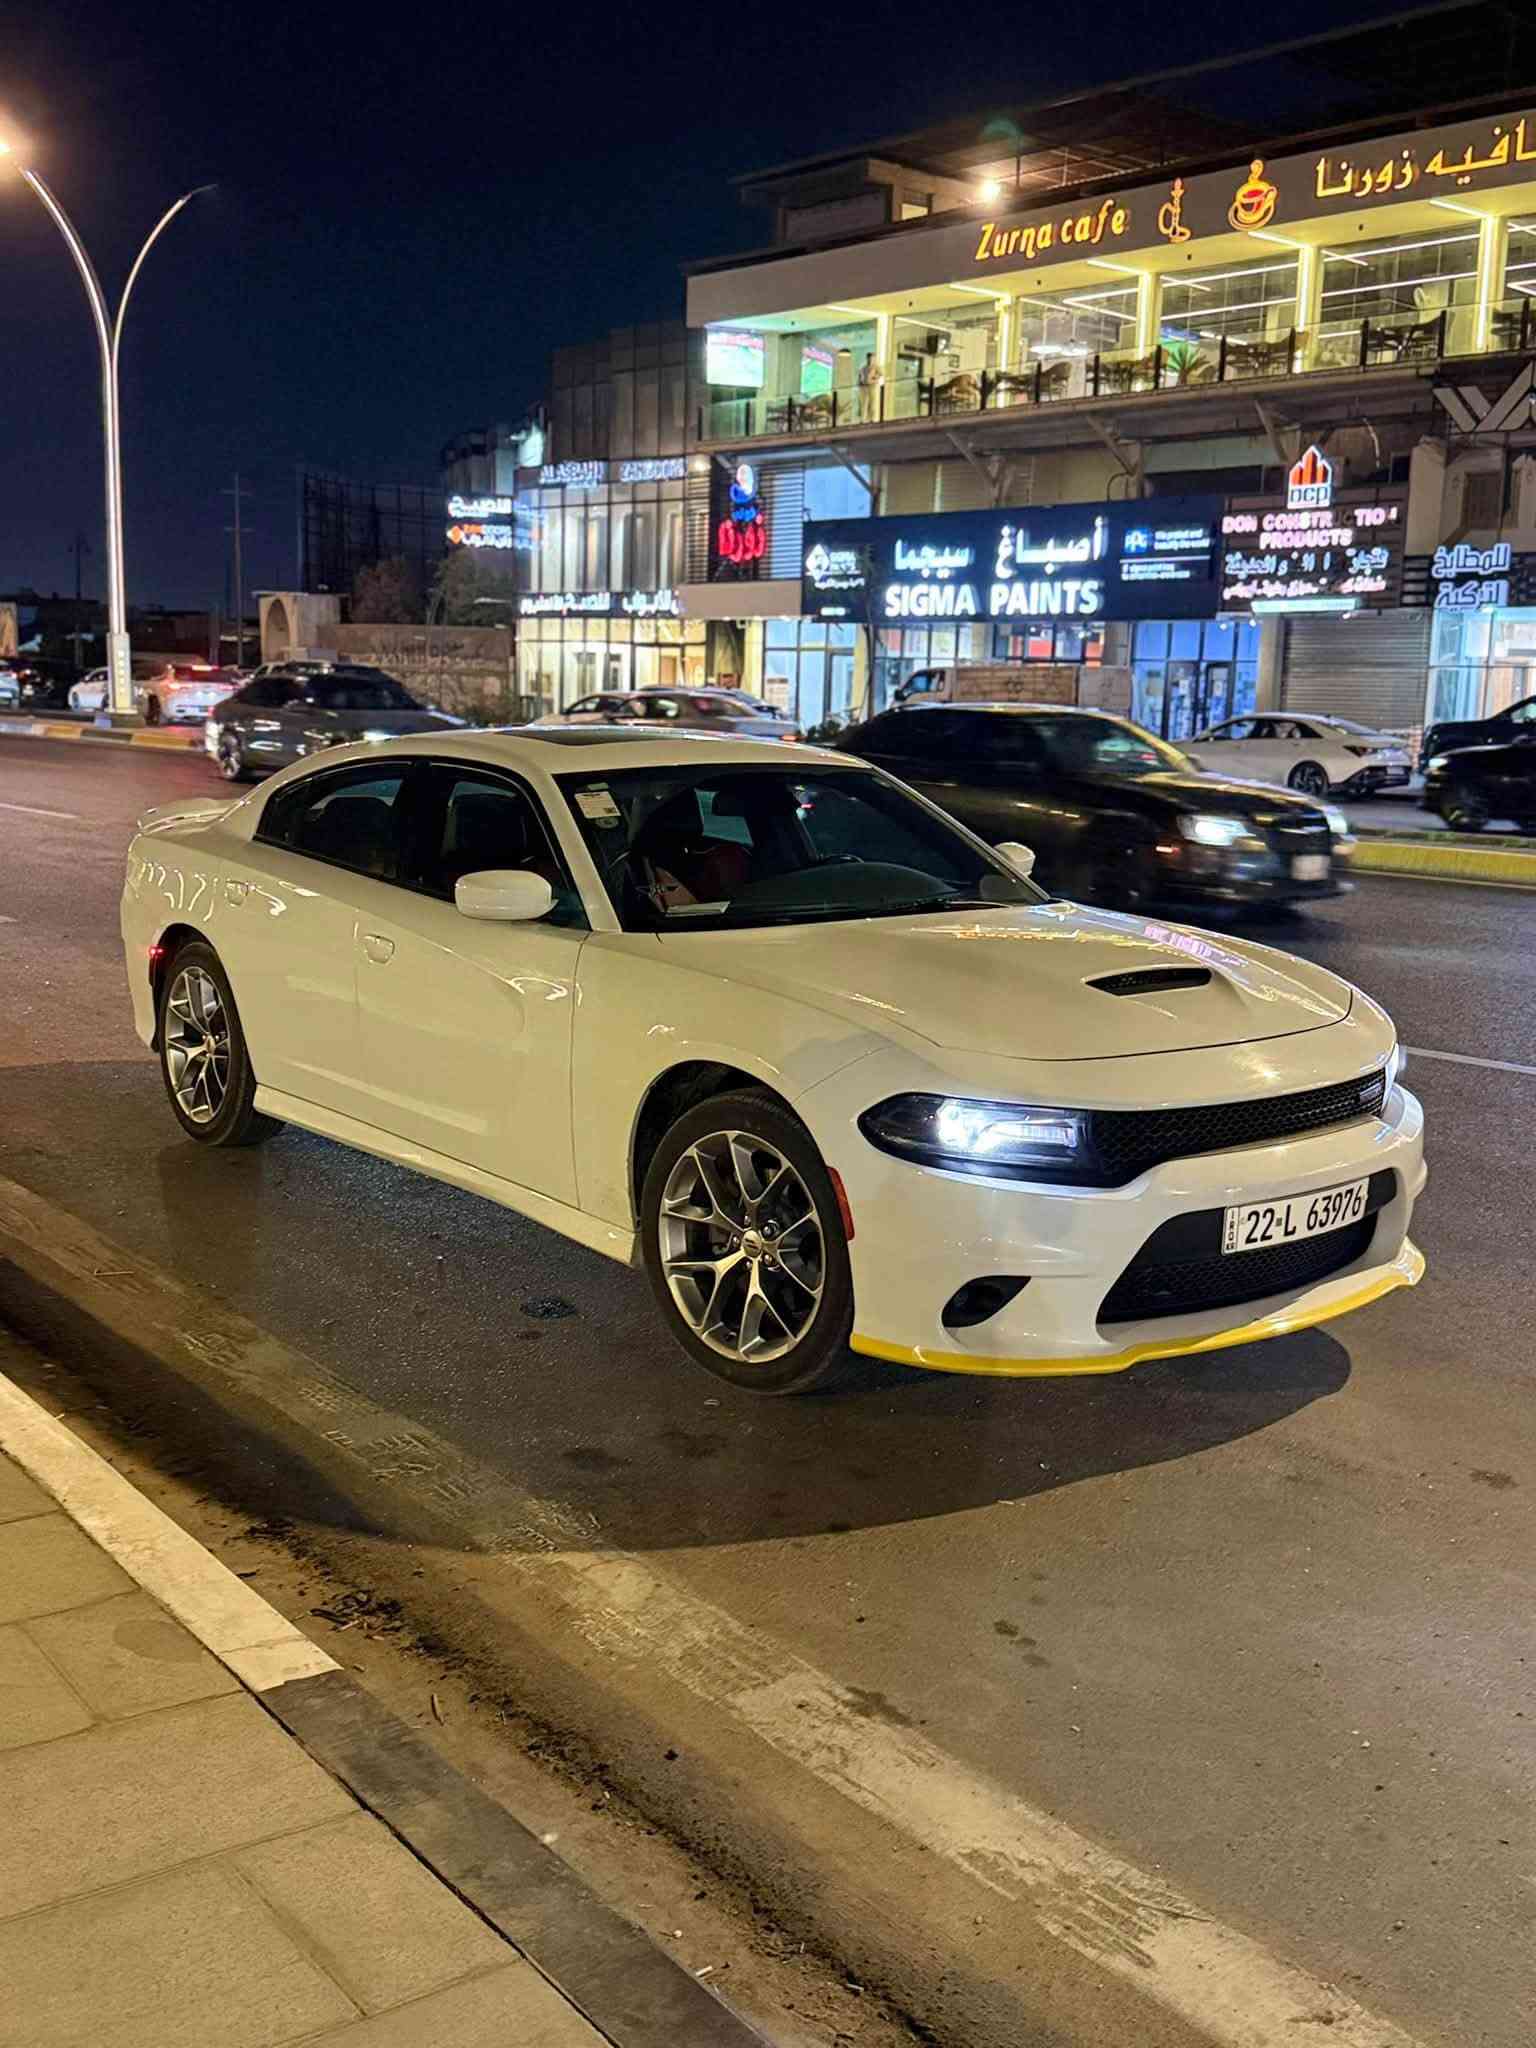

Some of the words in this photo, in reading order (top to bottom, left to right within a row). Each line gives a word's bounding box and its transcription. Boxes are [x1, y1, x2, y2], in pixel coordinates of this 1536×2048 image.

[1315, 149, 1413, 198] زورنا
[1425, 118, 1536, 185] افيه
[975, 223, 1052, 260] Zurna
[1061, 199, 1126, 244] cafe
[994, 515, 1103, 579] أصباغ
[1222, 514, 1258, 534] DON
[1260, 528, 1353, 550] PRODUCTS
[894, 539, 971, 579] سيجما
[884, 583, 976, 617] SIGMA
[989, 580, 1099, 616] PAINTS
[1306, 1184, 1363, 1232] 63976
